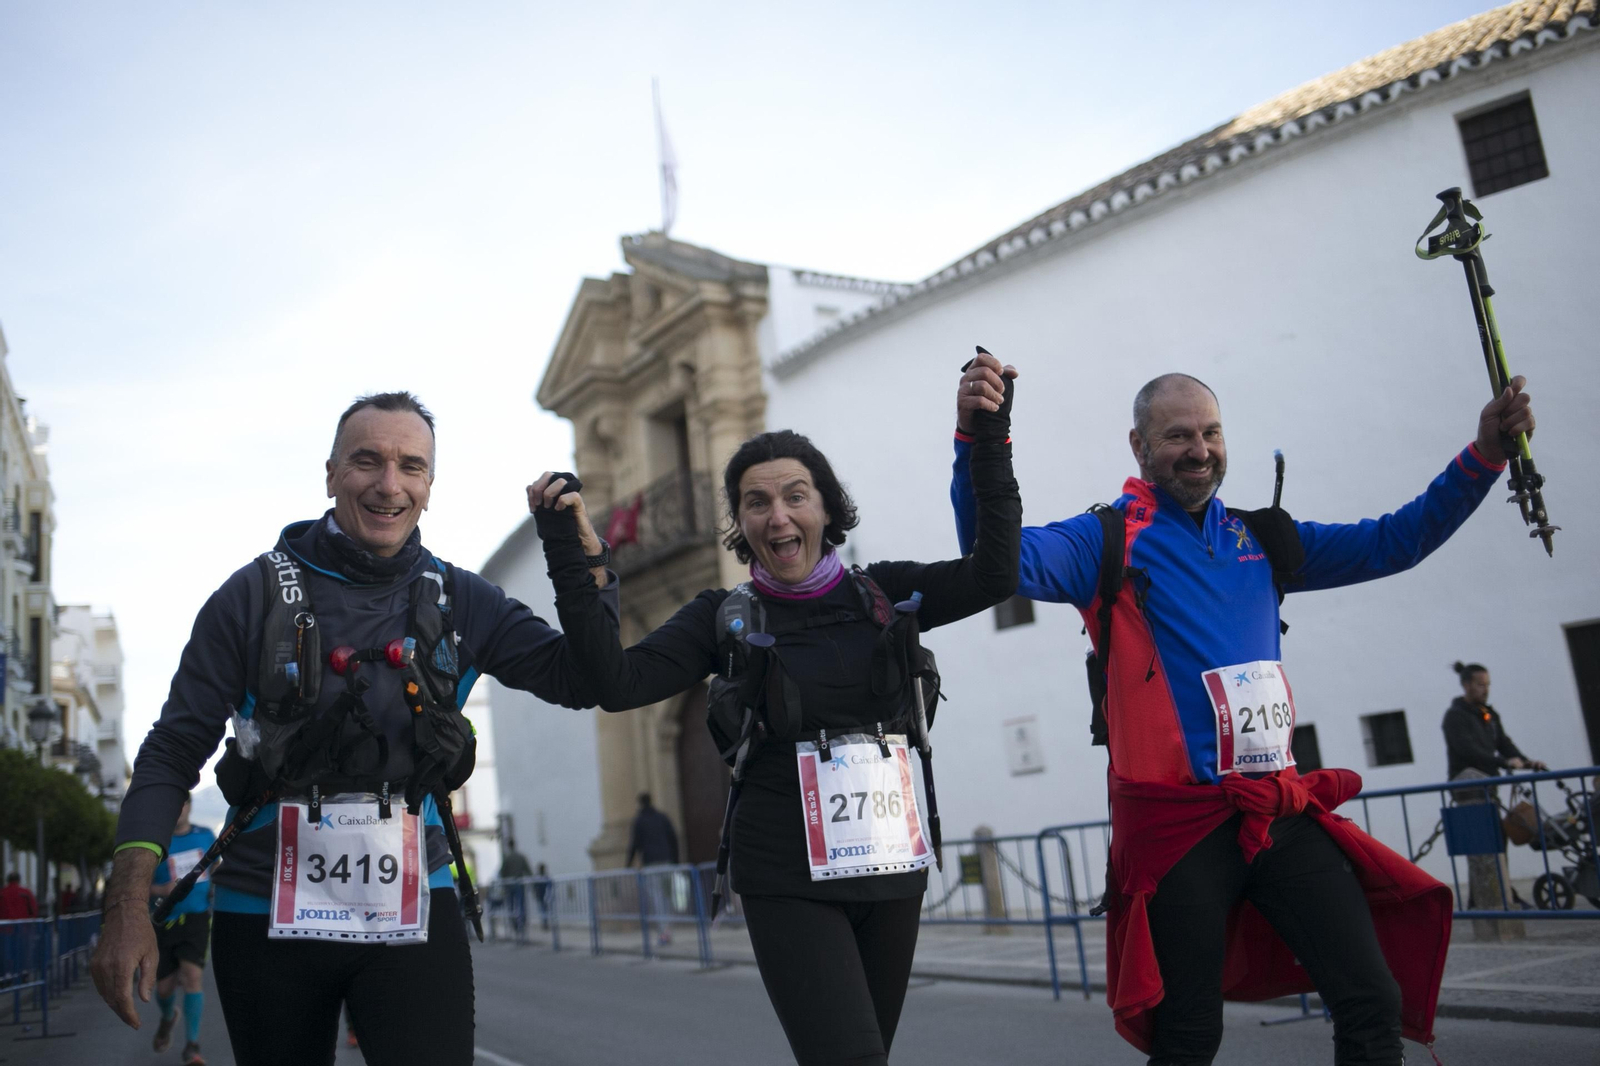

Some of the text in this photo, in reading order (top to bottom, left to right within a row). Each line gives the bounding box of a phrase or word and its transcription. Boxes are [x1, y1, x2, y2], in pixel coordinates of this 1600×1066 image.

[1439, 229, 1461, 246] altus
[1238, 701, 1292, 734] 2168
[828, 789, 902, 824] 2786
[306, 853, 399, 885] 3419
